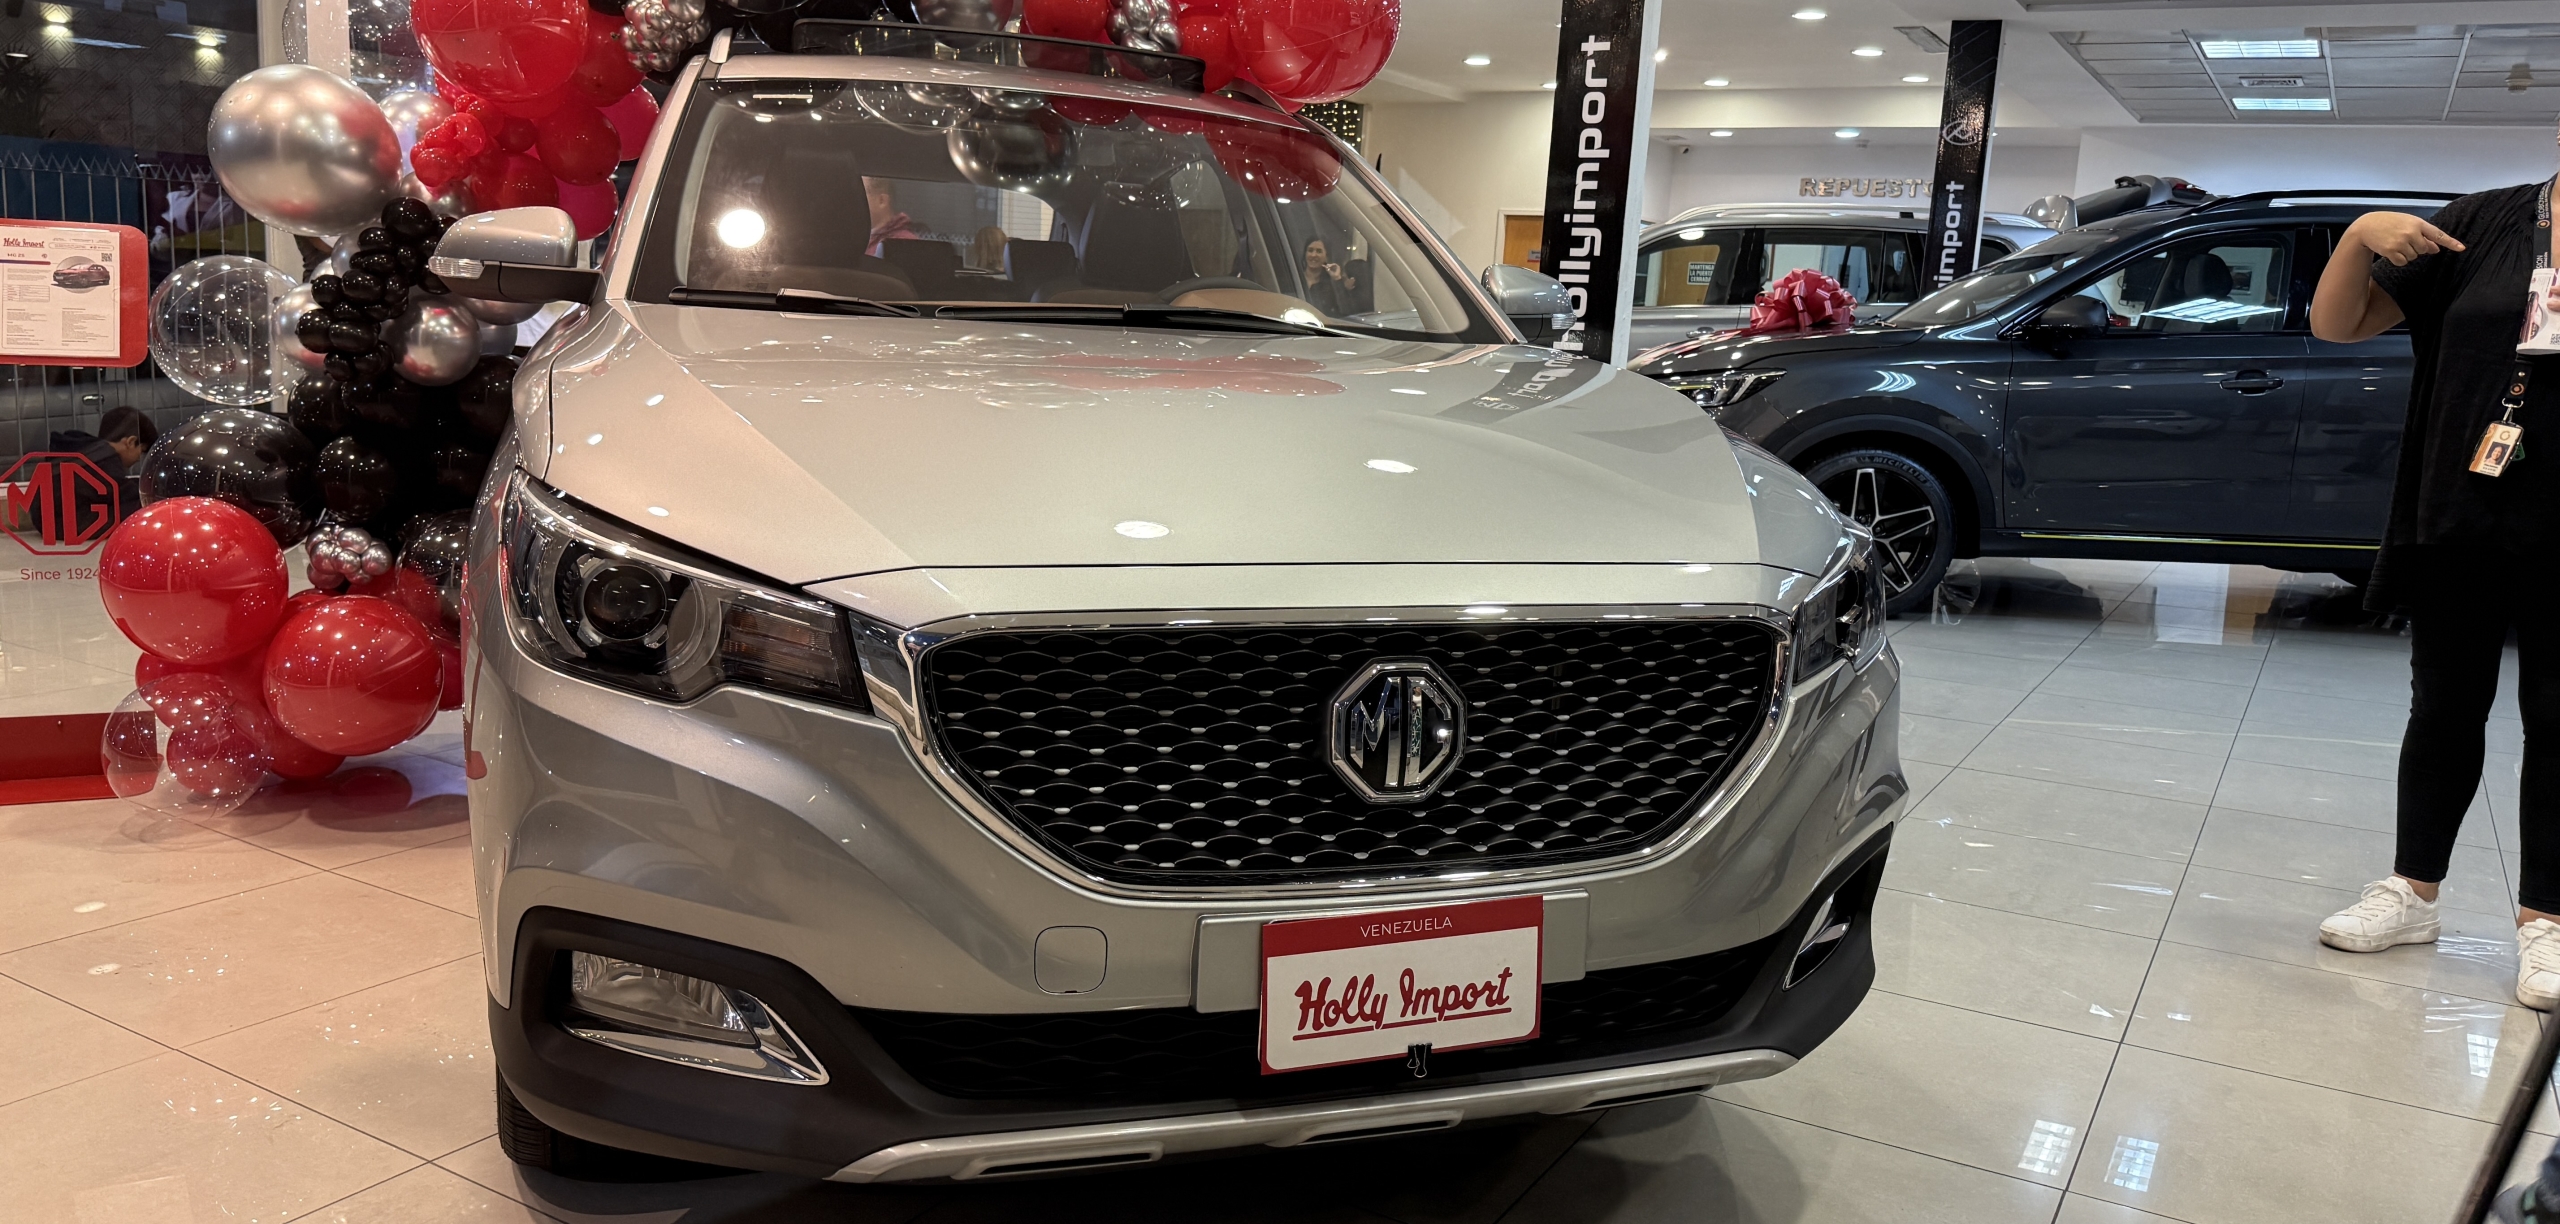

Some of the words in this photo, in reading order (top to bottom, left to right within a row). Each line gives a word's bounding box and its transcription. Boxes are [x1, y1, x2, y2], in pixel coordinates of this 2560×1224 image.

[6, 462, 109, 547] MG
[20, 568, 61, 581] Since
[1349, 675, 1454, 788] MG
[1360, 916, 1453, 938] VENEZUELA
[1294, 973, 1388, 1031] Holly
[1399, 967, 1512, 1021] Import
